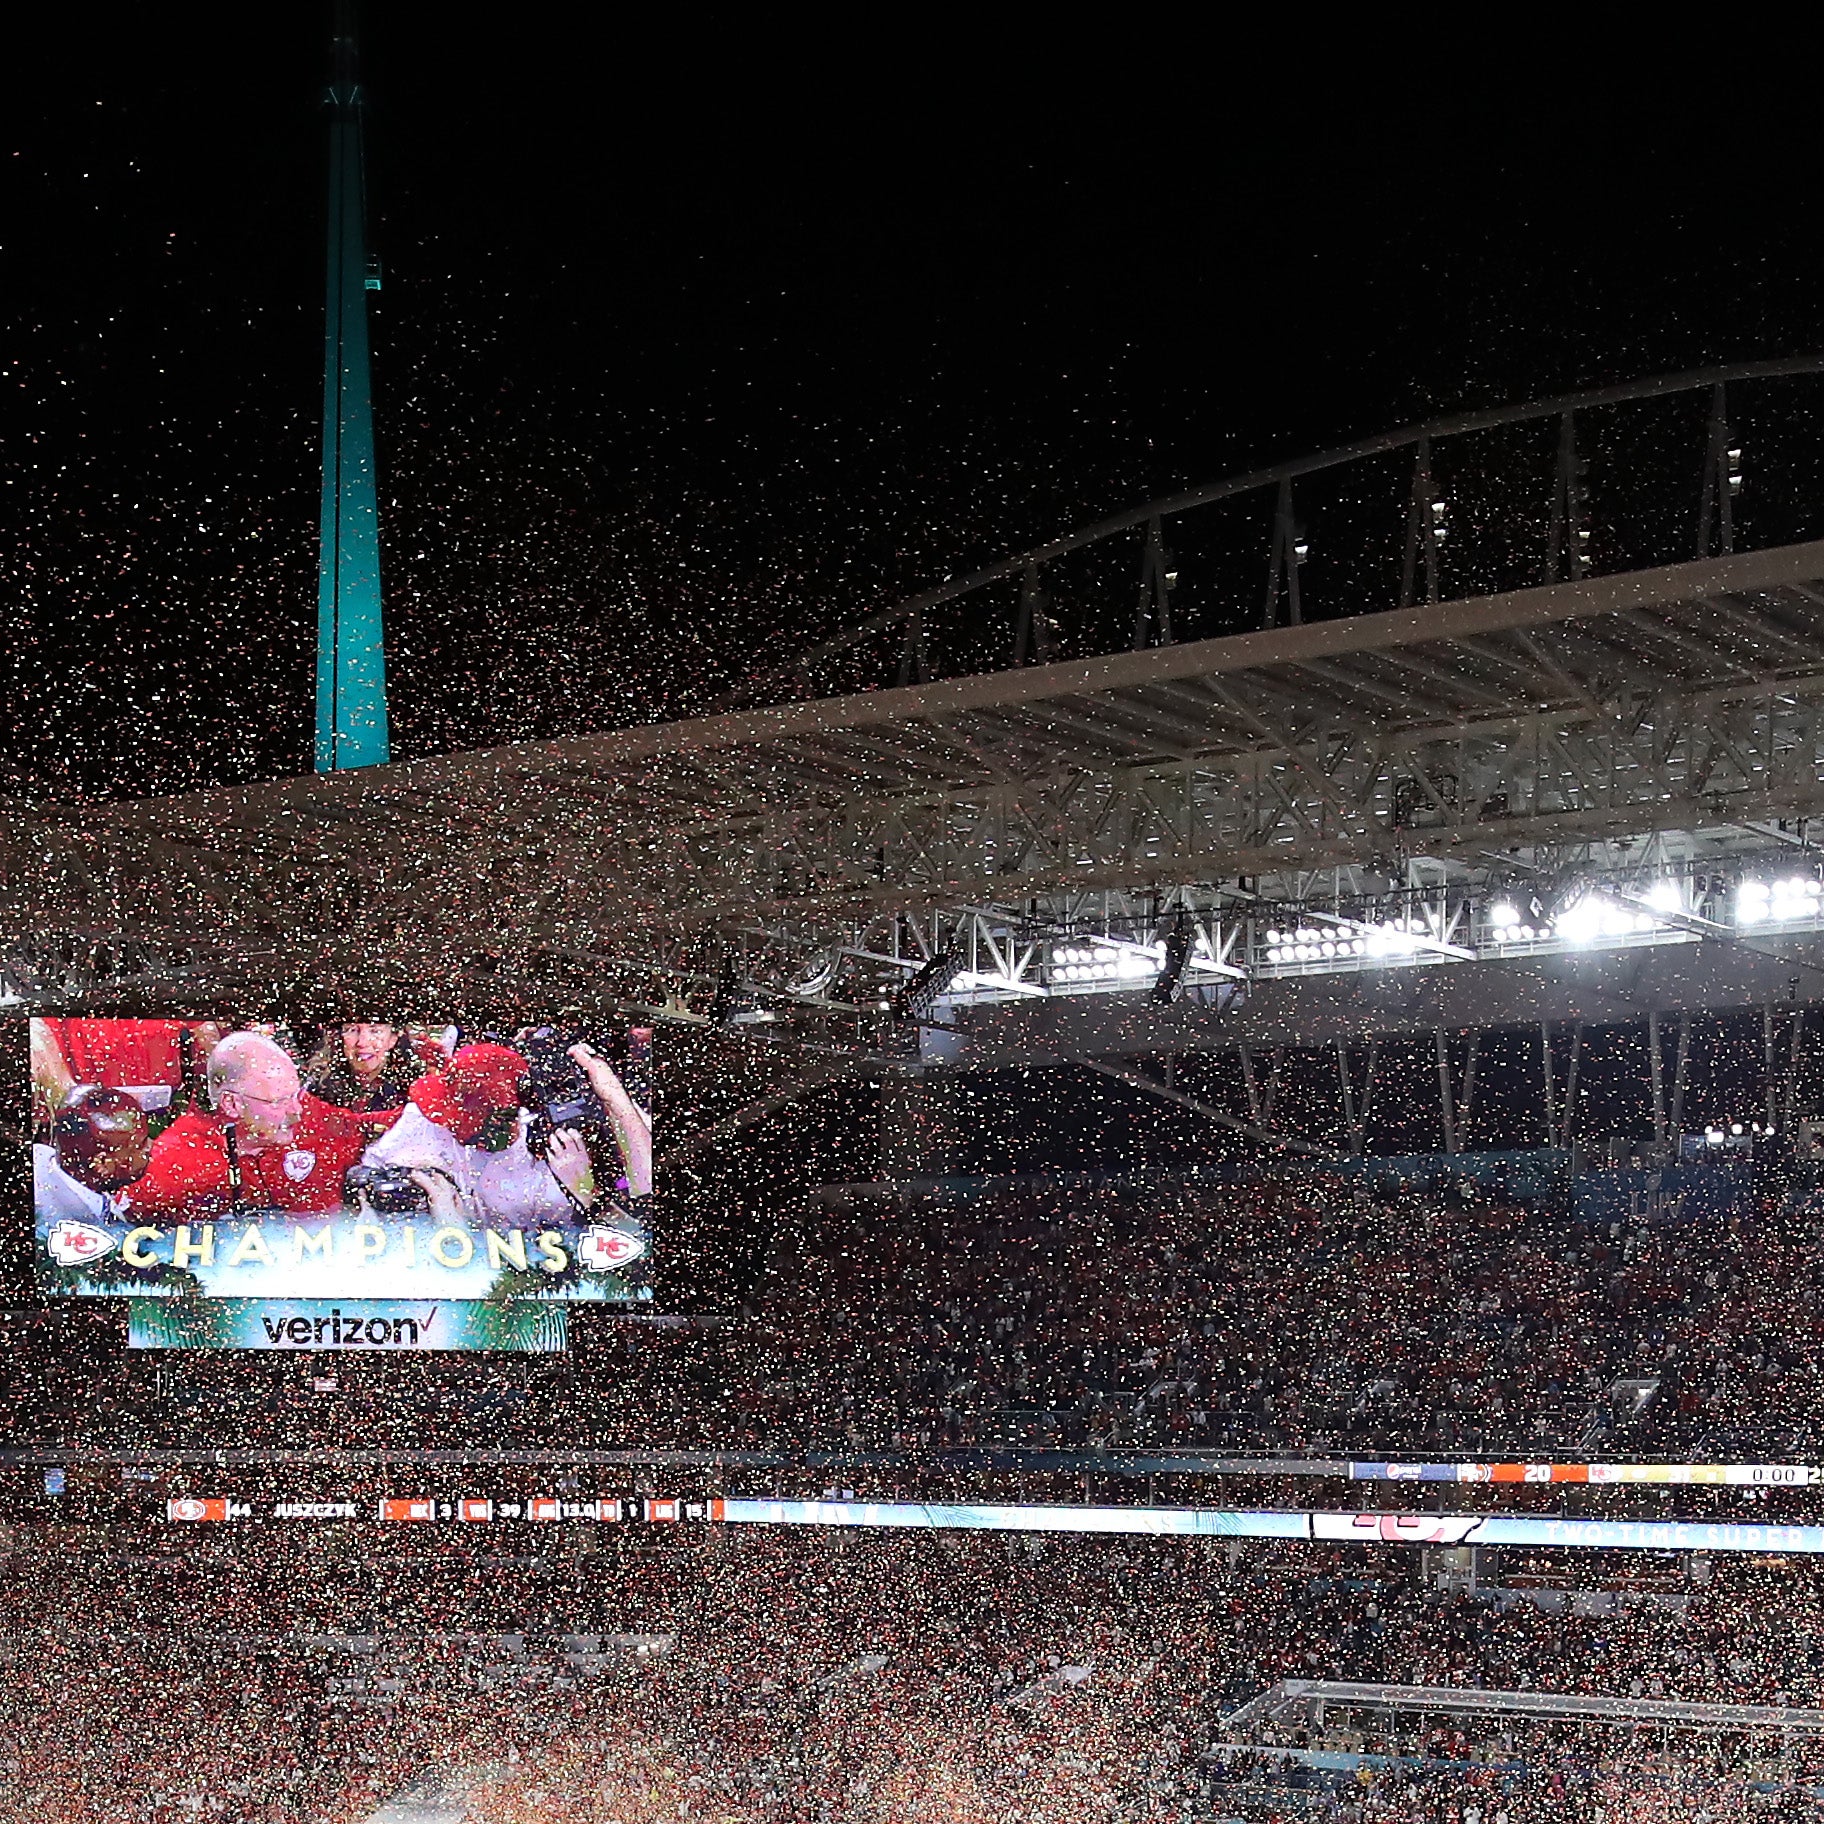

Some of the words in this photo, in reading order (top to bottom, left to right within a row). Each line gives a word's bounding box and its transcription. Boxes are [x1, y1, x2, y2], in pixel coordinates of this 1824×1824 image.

[121, 1221, 568, 1273] CHAMPIONS
[263, 1307, 419, 1345] verizon
[1525, 1465, 1551, 1482] 20
[1752, 1468, 1795, 1482] 0:00
[229, 1504, 251, 1517] 44
[274, 1503, 356, 1518] JUSZCZYK
[439, 1504, 452, 1517] 3
[499, 1503, 520, 1518] 39
[563, 1503, 596, 1517] 13.0
[629, 1503, 638, 1517] 1
[685, 1504, 703, 1517] 15
[1545, 1521, 1690, 1543] TWO-TIME
[1708, 1524, 1803, 1547] SUPER
